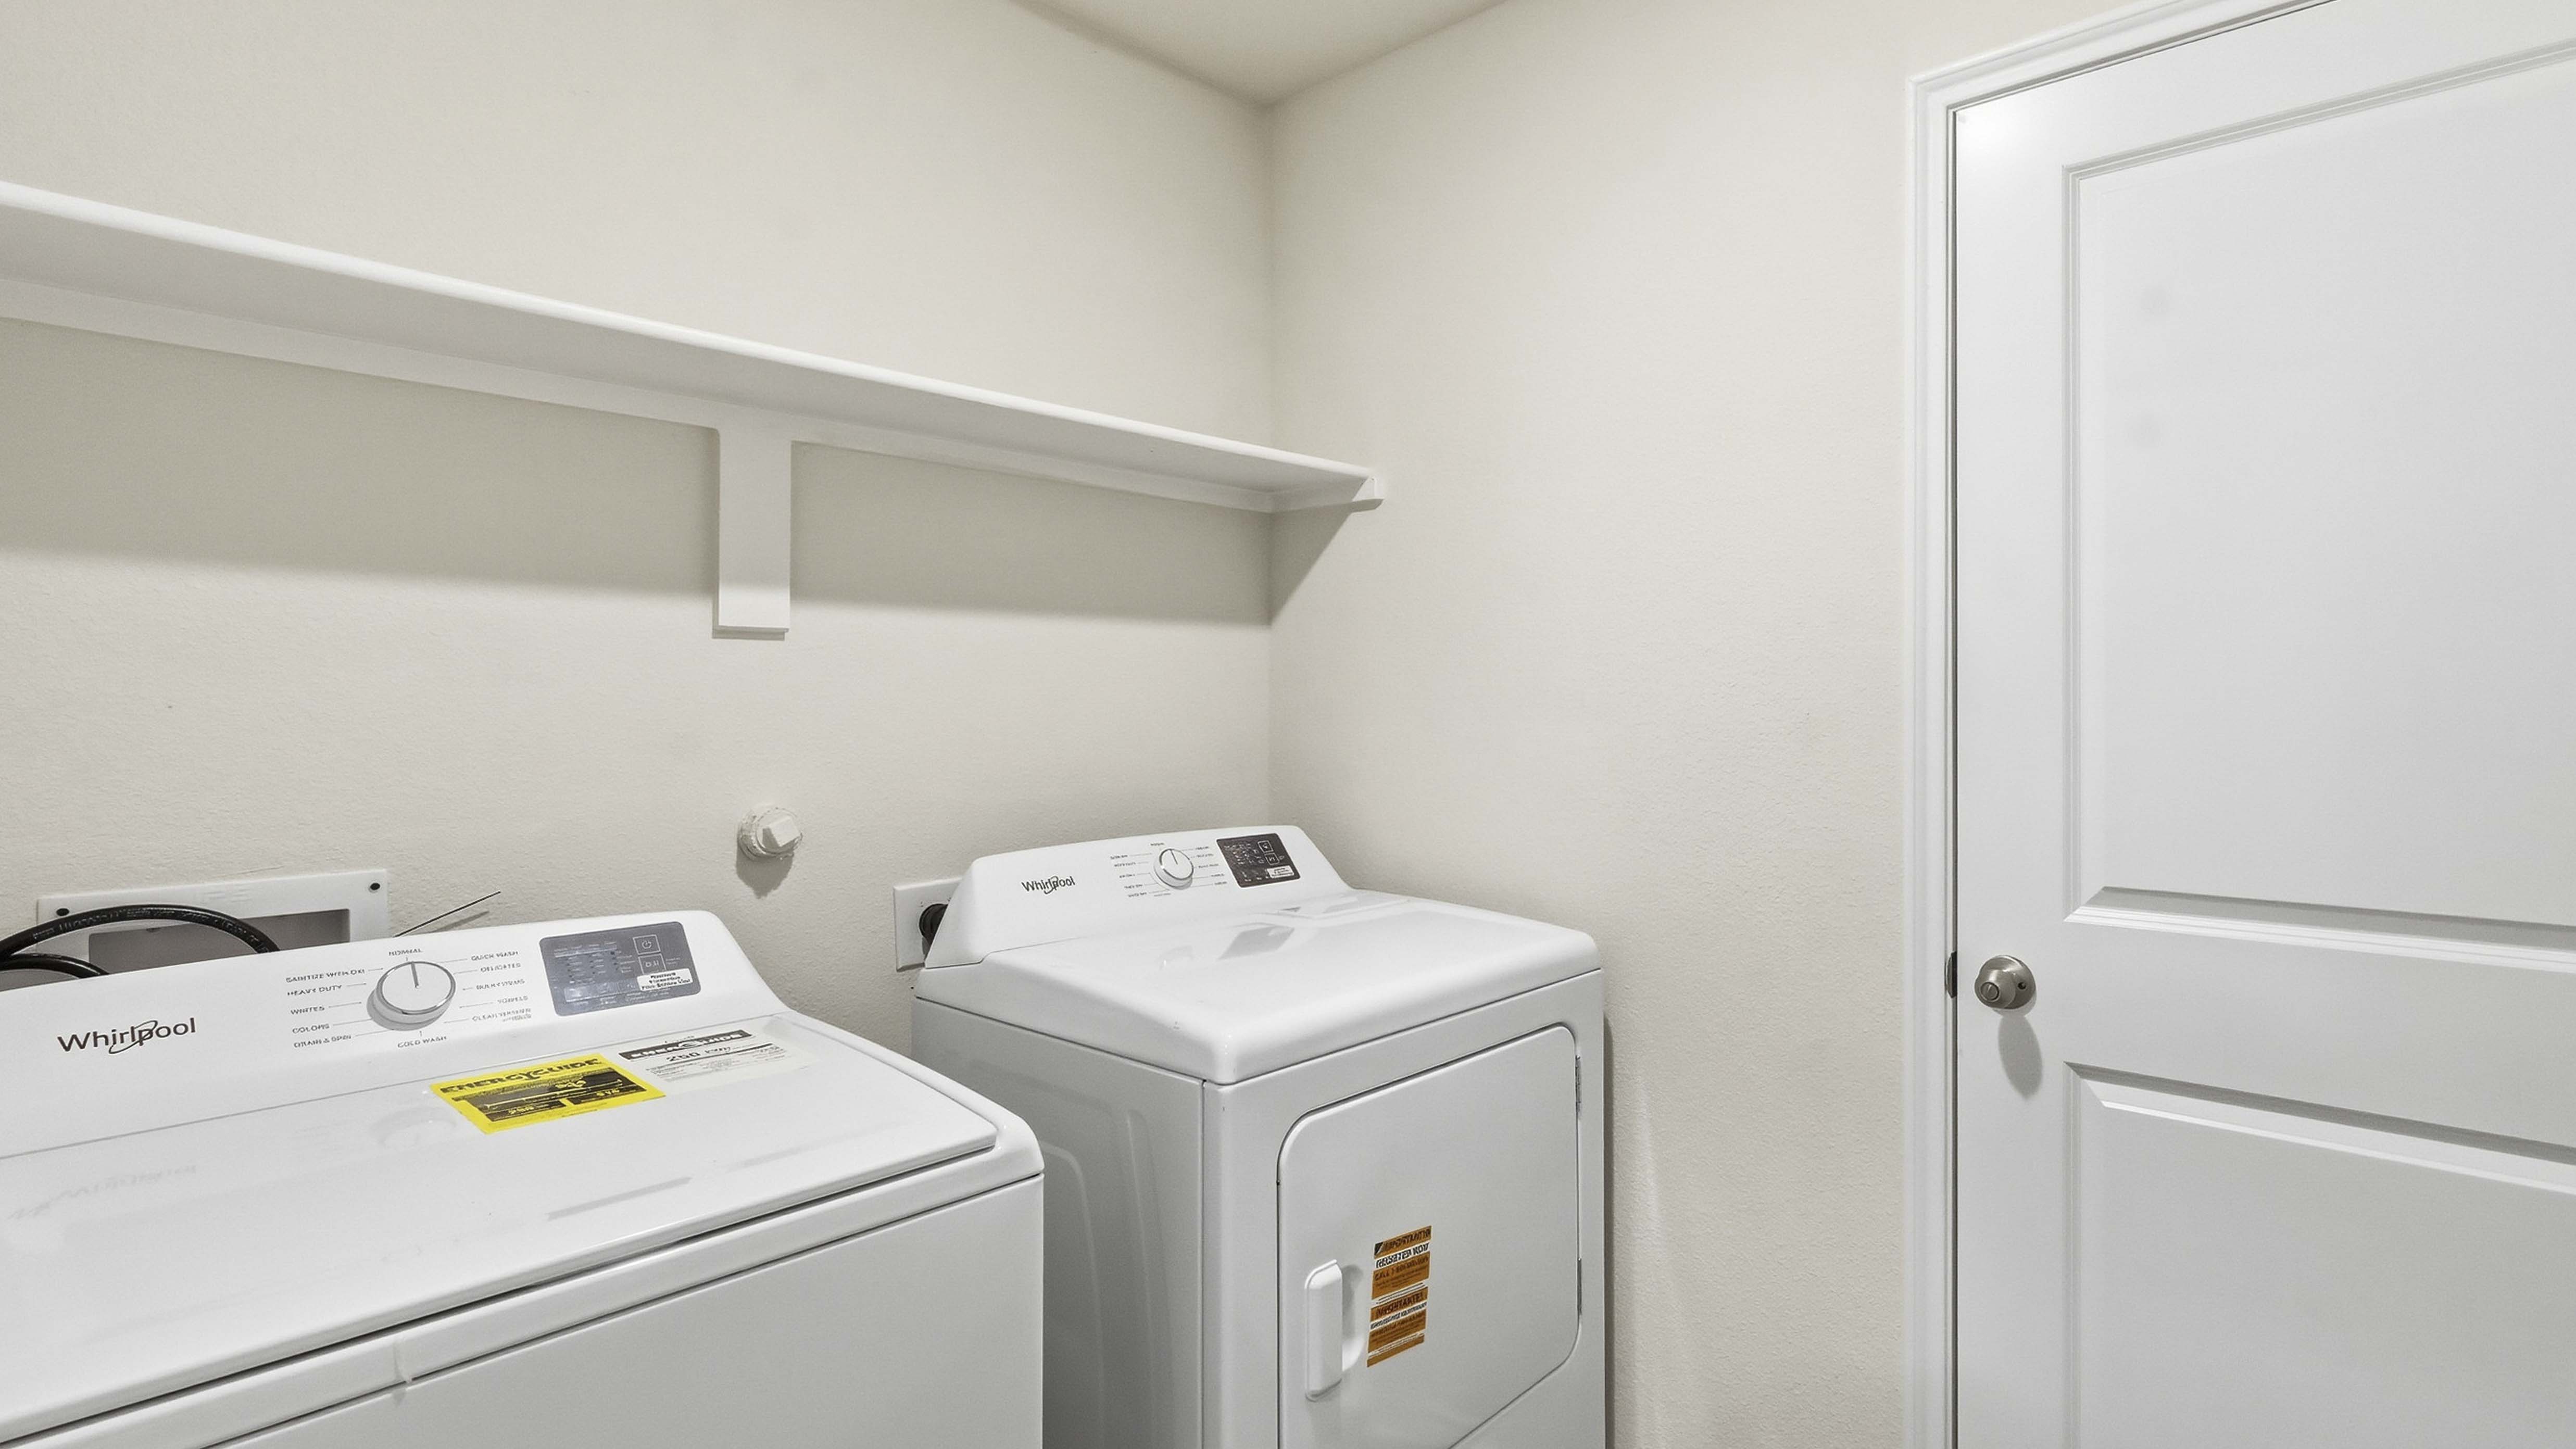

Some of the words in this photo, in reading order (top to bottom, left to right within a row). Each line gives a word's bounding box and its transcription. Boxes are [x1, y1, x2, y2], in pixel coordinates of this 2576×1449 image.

[1021, 875, 1075, 894] Whirlpool
[290, 1006, 325, 1015] WHITES
[57, 1017, 196, 1054] Whirlpool
[397, 1040, 421, 1048] COLD
[1412, 1242, 1430, 1255] NOW
